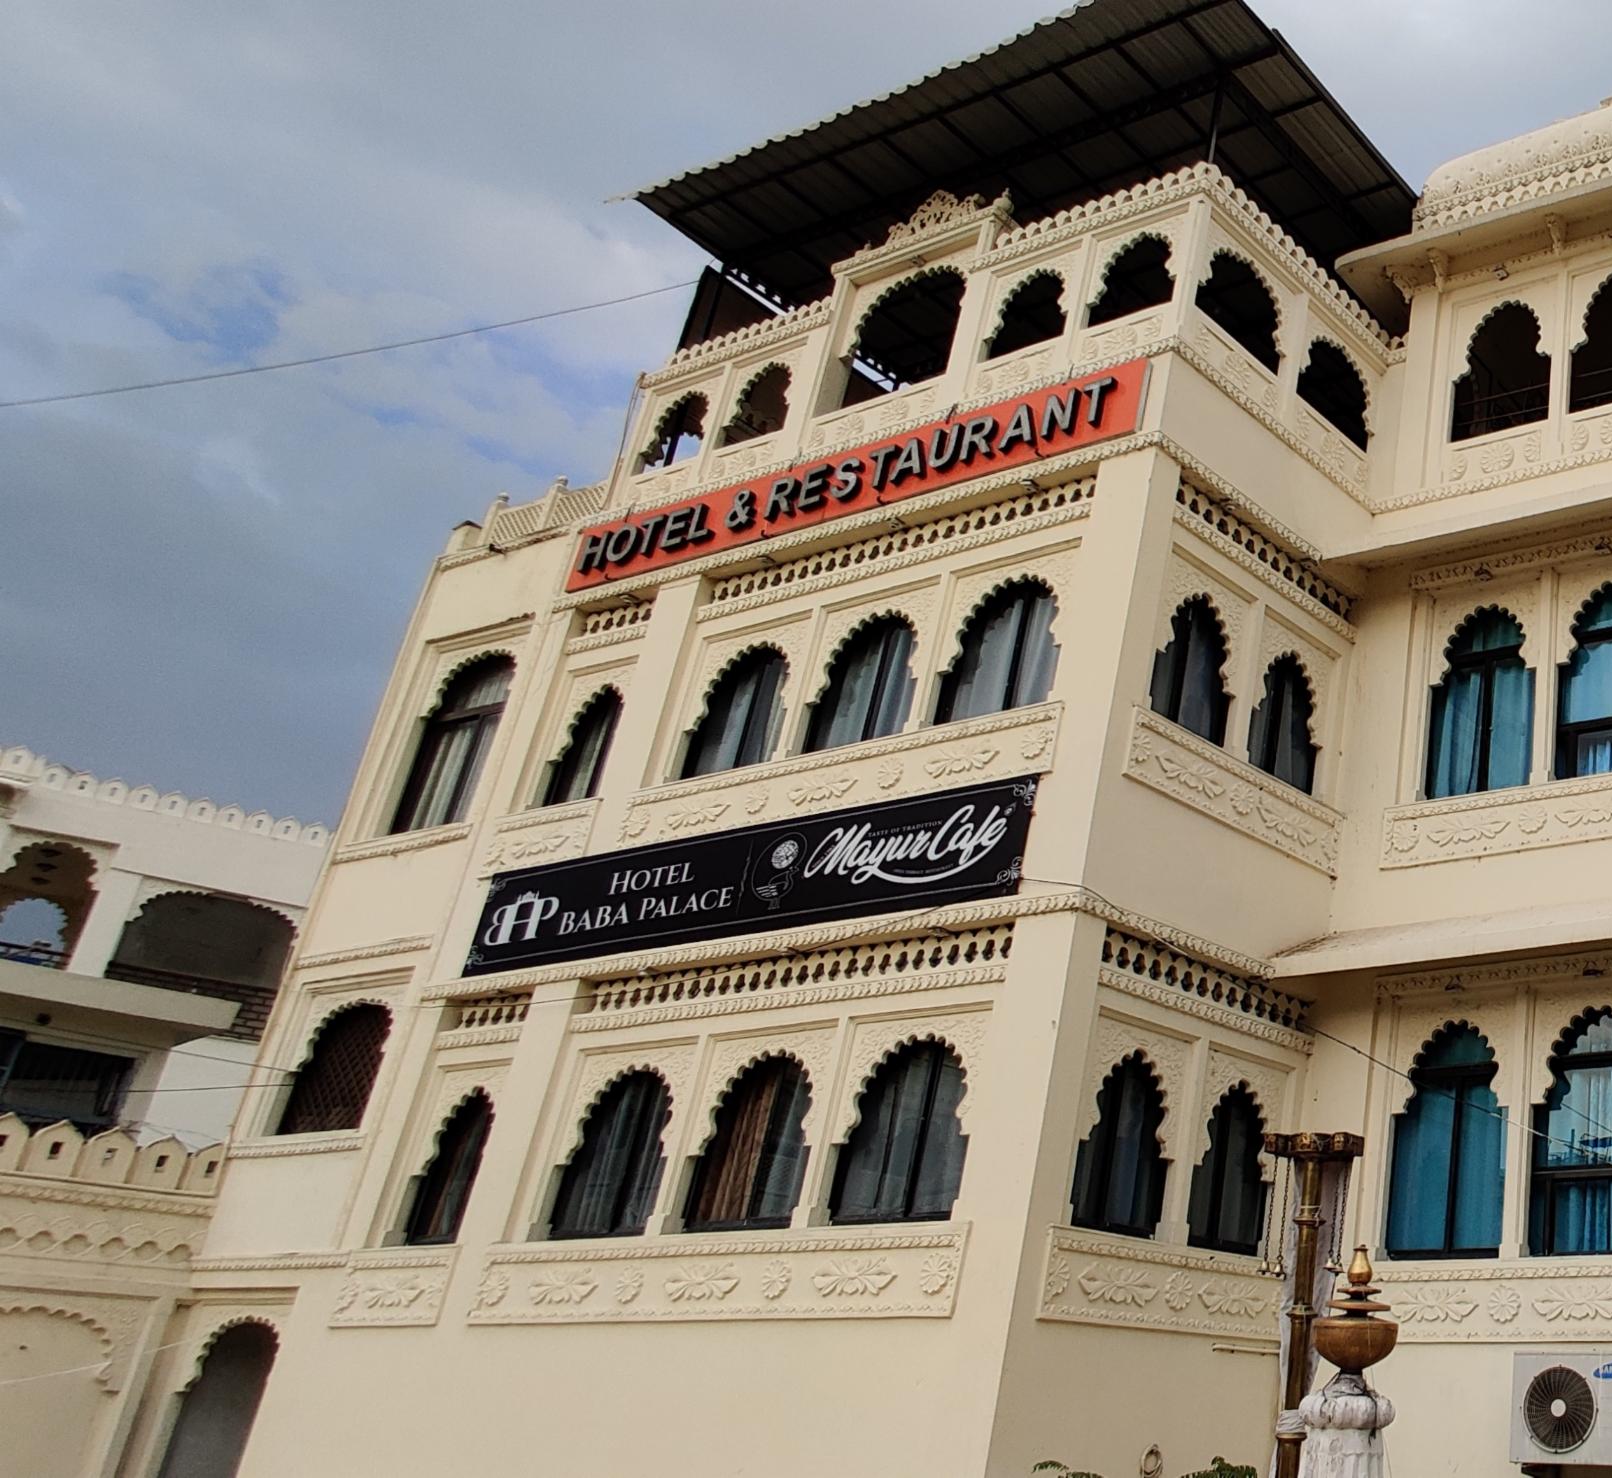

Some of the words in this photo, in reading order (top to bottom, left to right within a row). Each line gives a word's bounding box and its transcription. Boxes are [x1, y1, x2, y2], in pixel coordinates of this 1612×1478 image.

[577, 504, 713, 573] HOTEL
[723, 491, 757, 531] &
[762, 377, 1113, 521] RESTAURANT
[609, 862, 695, 896] HOTEL
[804, 822, 932, 884] Mayur
[557, 902, 629, 936] BABA
[637, 886, 735, 921] PALACE
